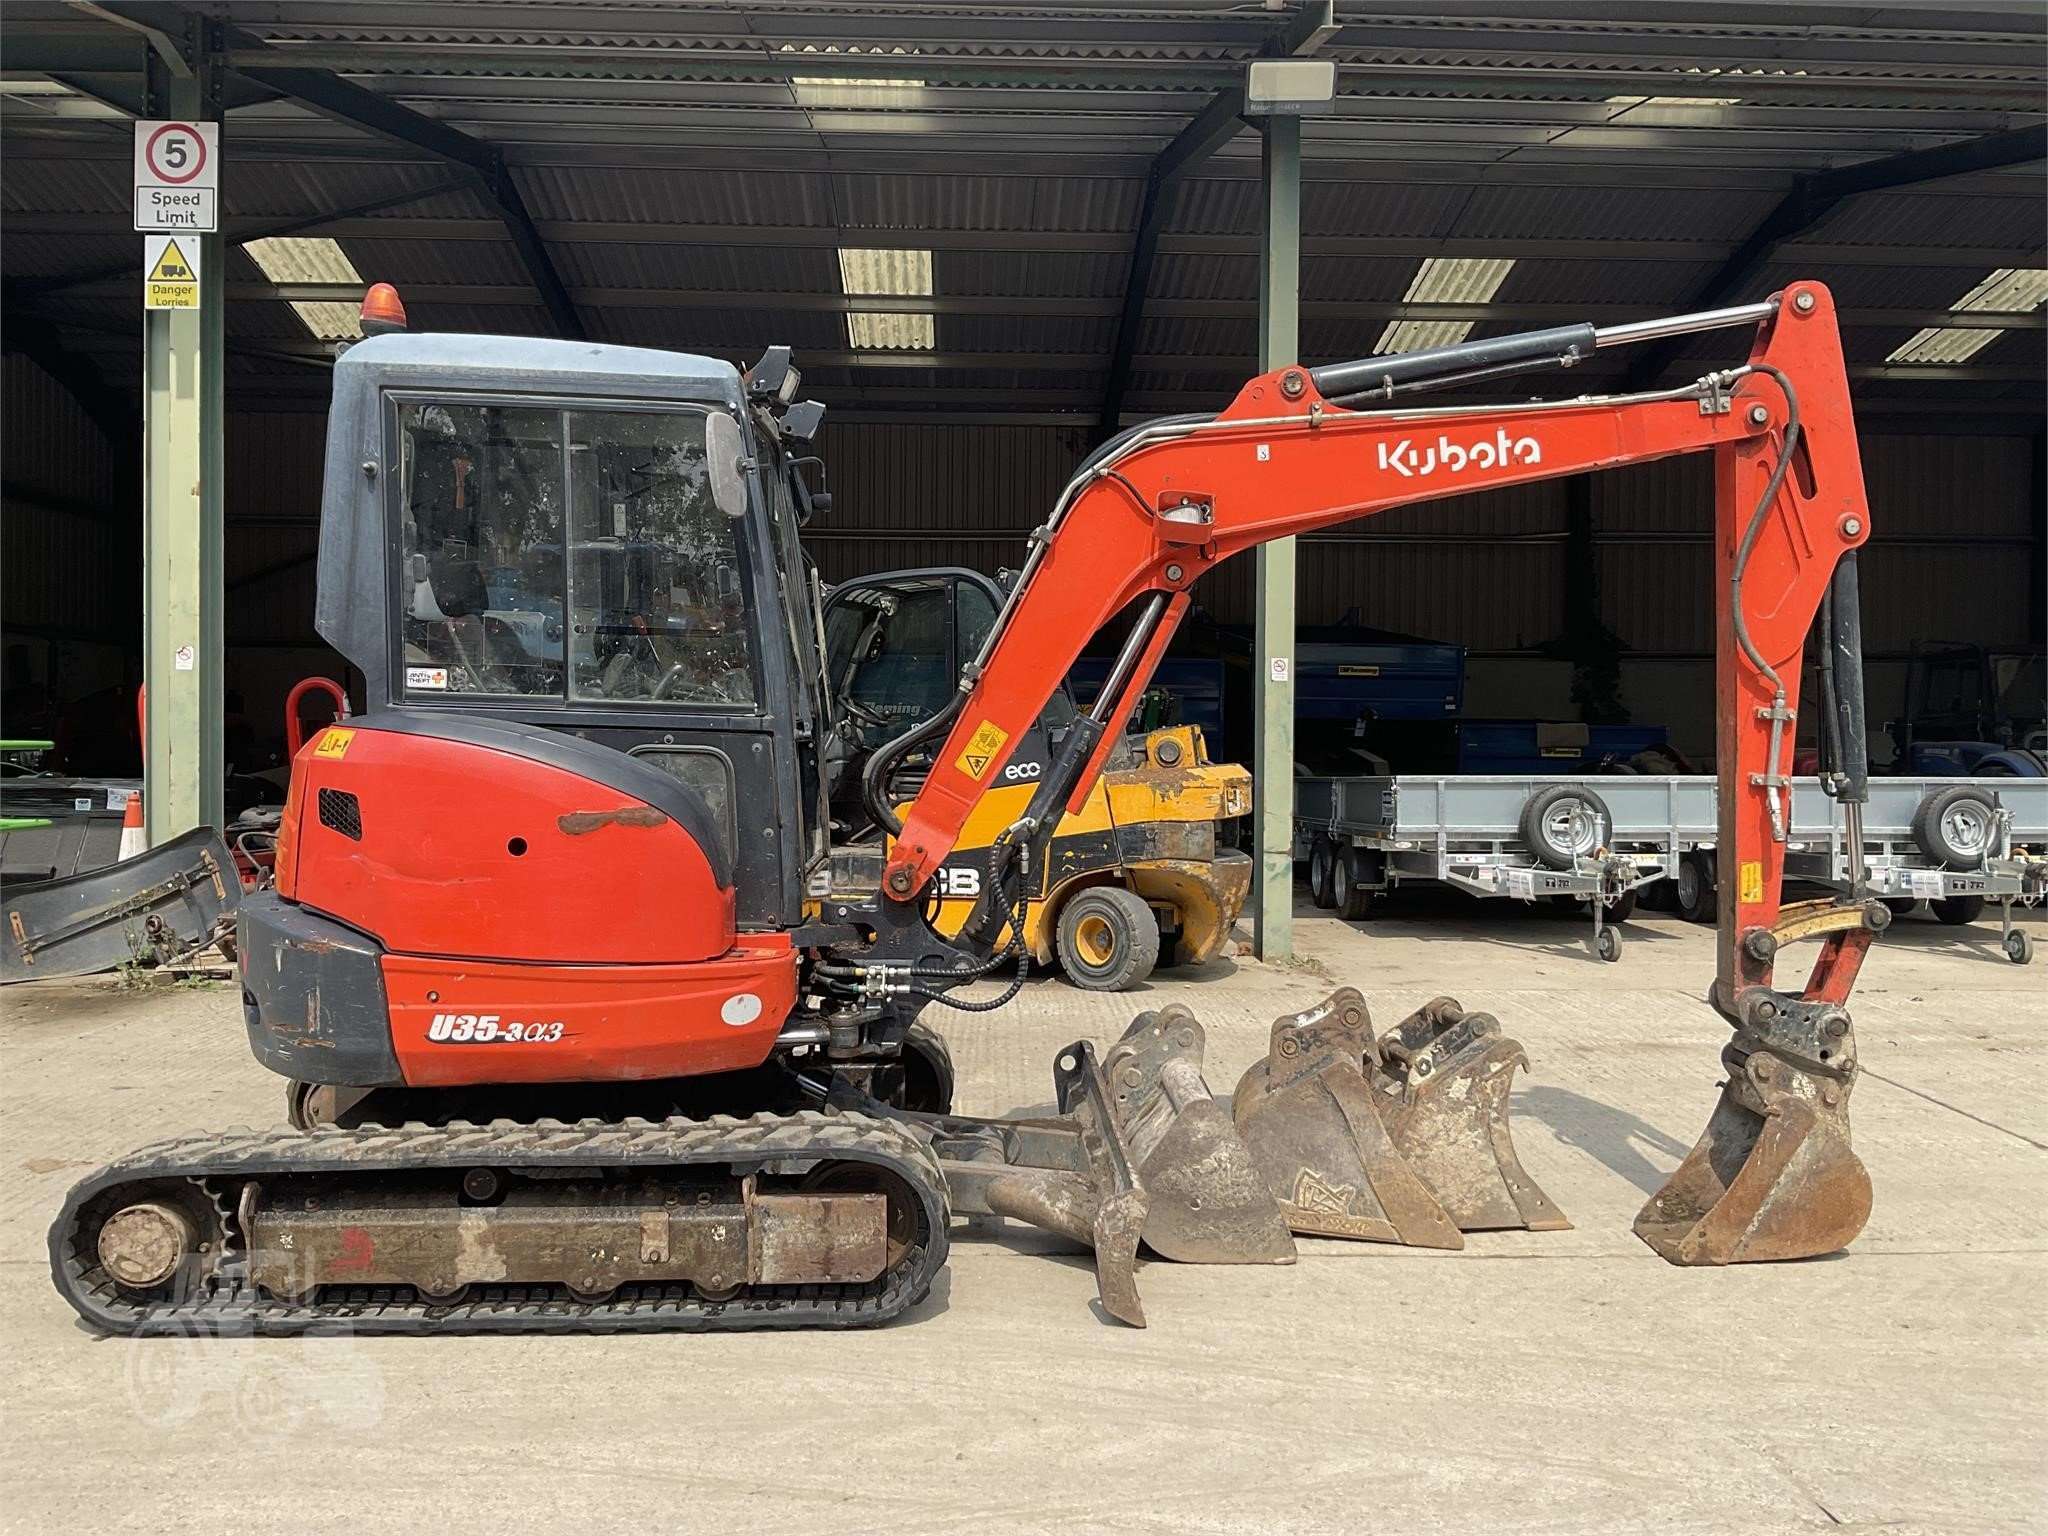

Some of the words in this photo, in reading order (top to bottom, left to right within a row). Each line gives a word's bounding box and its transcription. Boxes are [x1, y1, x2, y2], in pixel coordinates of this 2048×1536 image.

[165, 138, 187, 168] 5
[151, 191, 200, 208] Speed
[156, 210, 196, 224] Limit
[152, 285, 193, 298] Danger
[155, 297, 190, 307] Lorries
[1377, 426, 1541, 477] Kubota
[1005, 761, 1041, 780] eco
